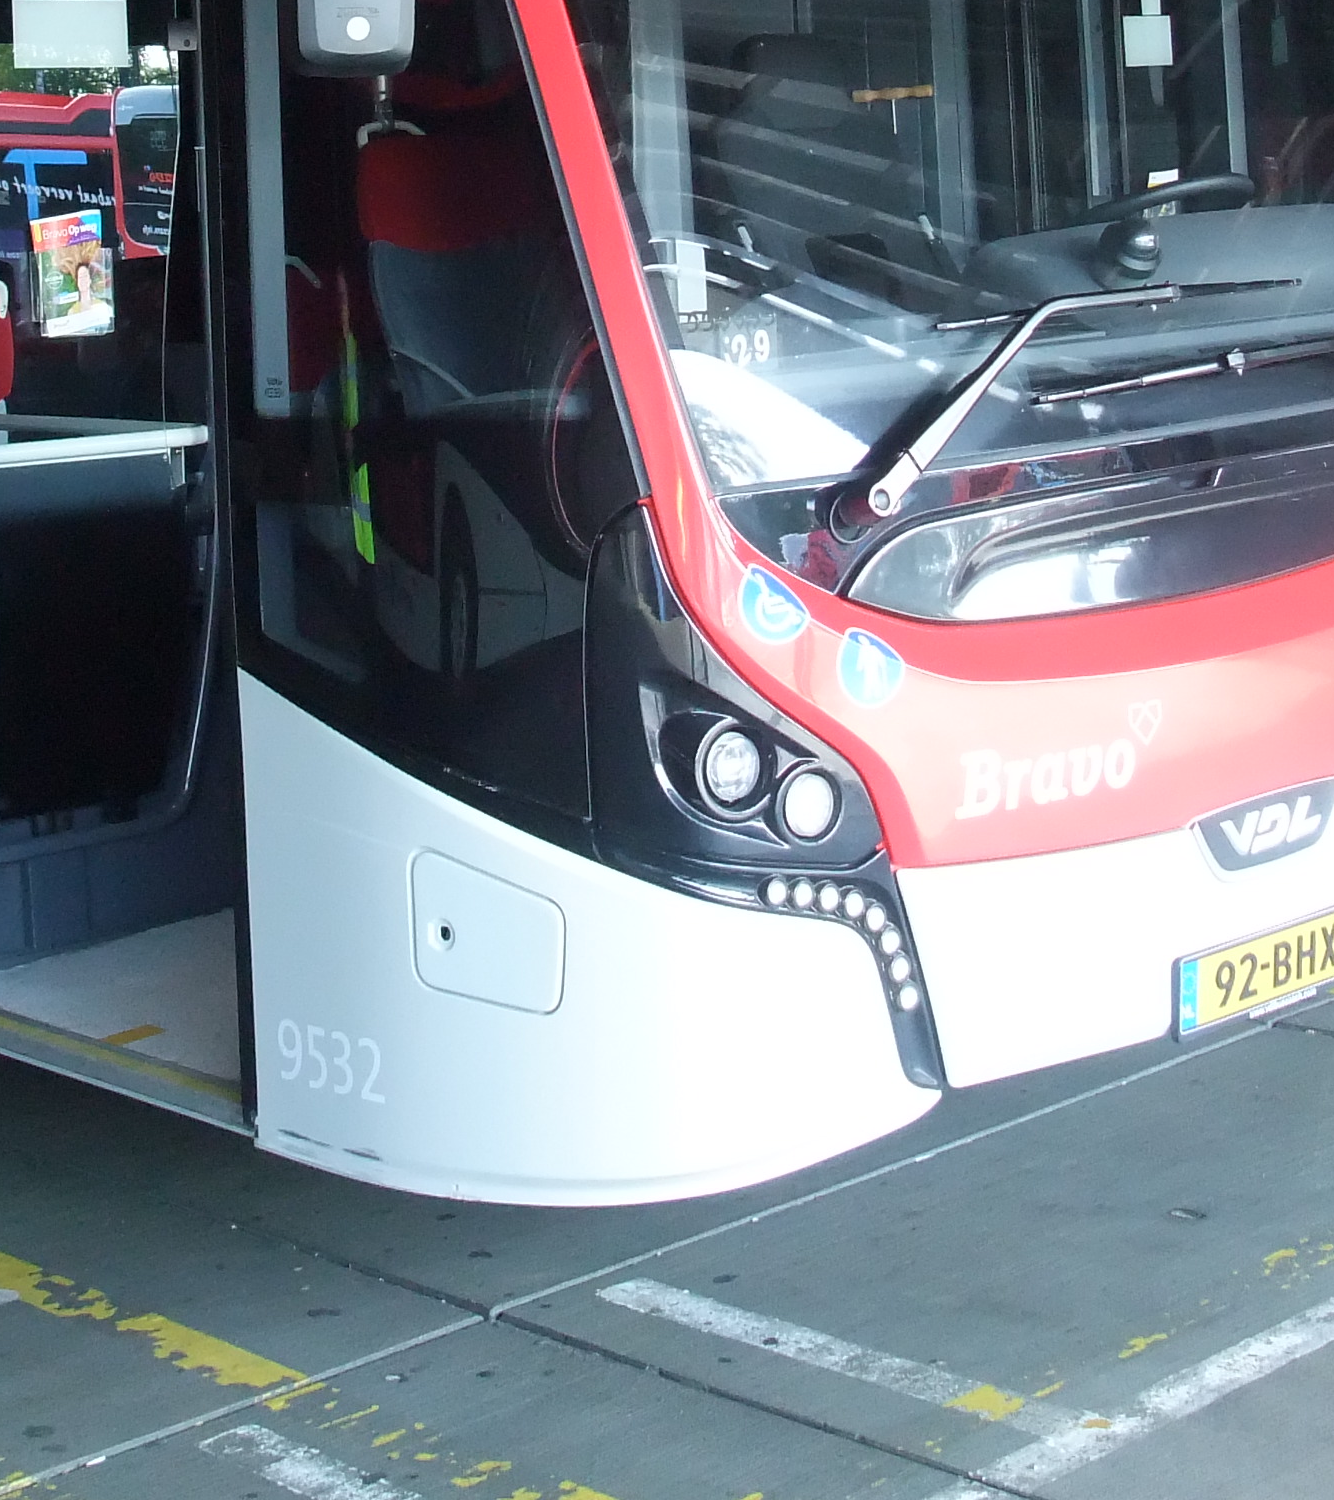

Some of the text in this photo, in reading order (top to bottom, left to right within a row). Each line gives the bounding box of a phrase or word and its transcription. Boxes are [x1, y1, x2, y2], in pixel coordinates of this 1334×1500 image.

[953, 737, 1137, 821] Bravo
[1219, 794, 1323, 857] VDL
[277, 1017, 387, 1104] 9532
